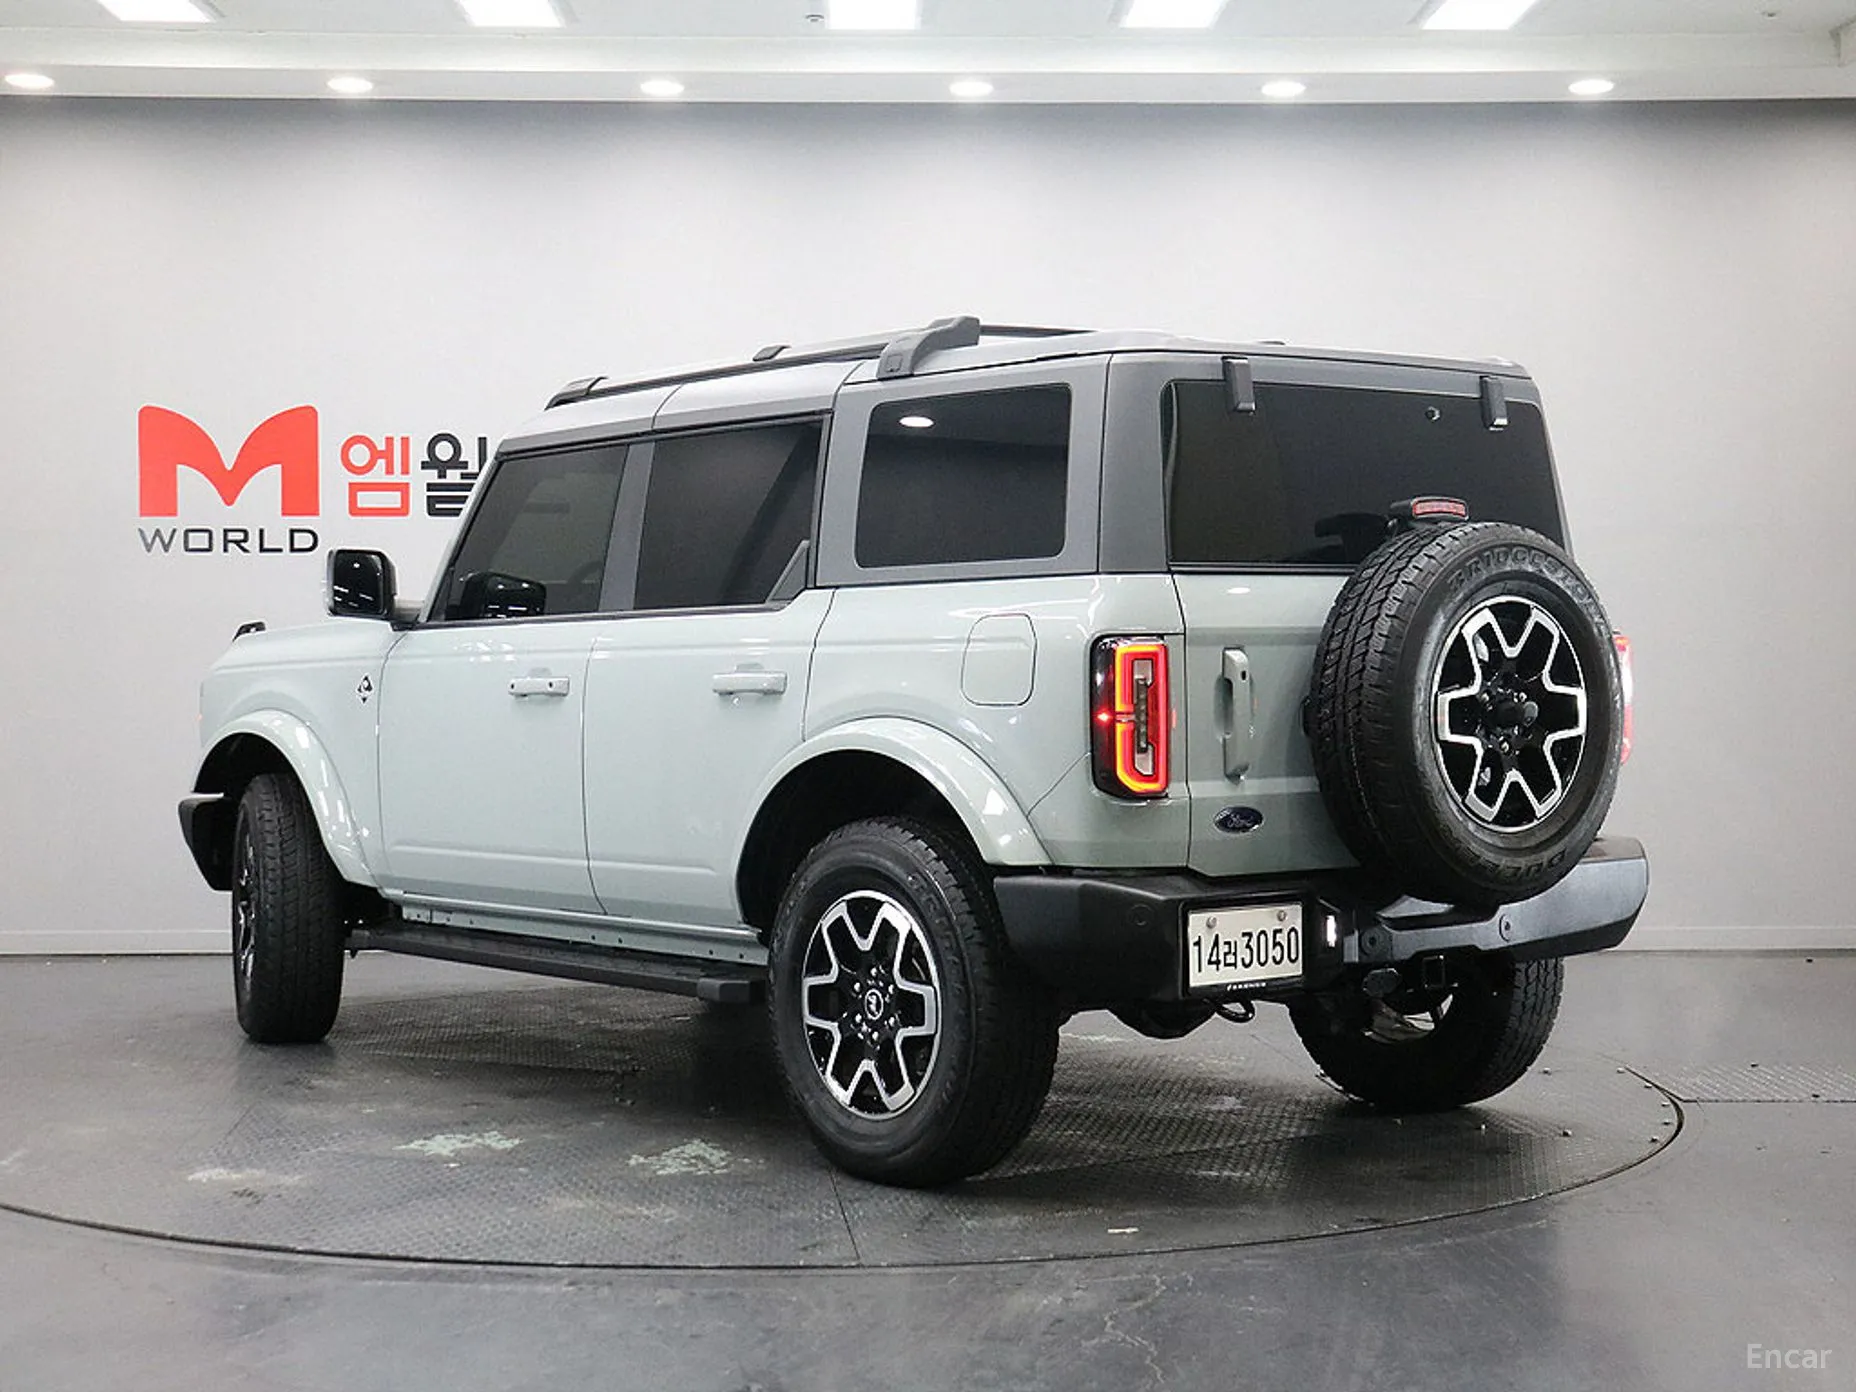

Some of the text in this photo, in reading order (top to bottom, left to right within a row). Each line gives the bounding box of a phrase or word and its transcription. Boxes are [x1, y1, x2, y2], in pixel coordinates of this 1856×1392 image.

[138, 404, 320, 517] M
[138, 528, 319, 553] WORLD
[1192, 926, 1300, 974] 14러3050
